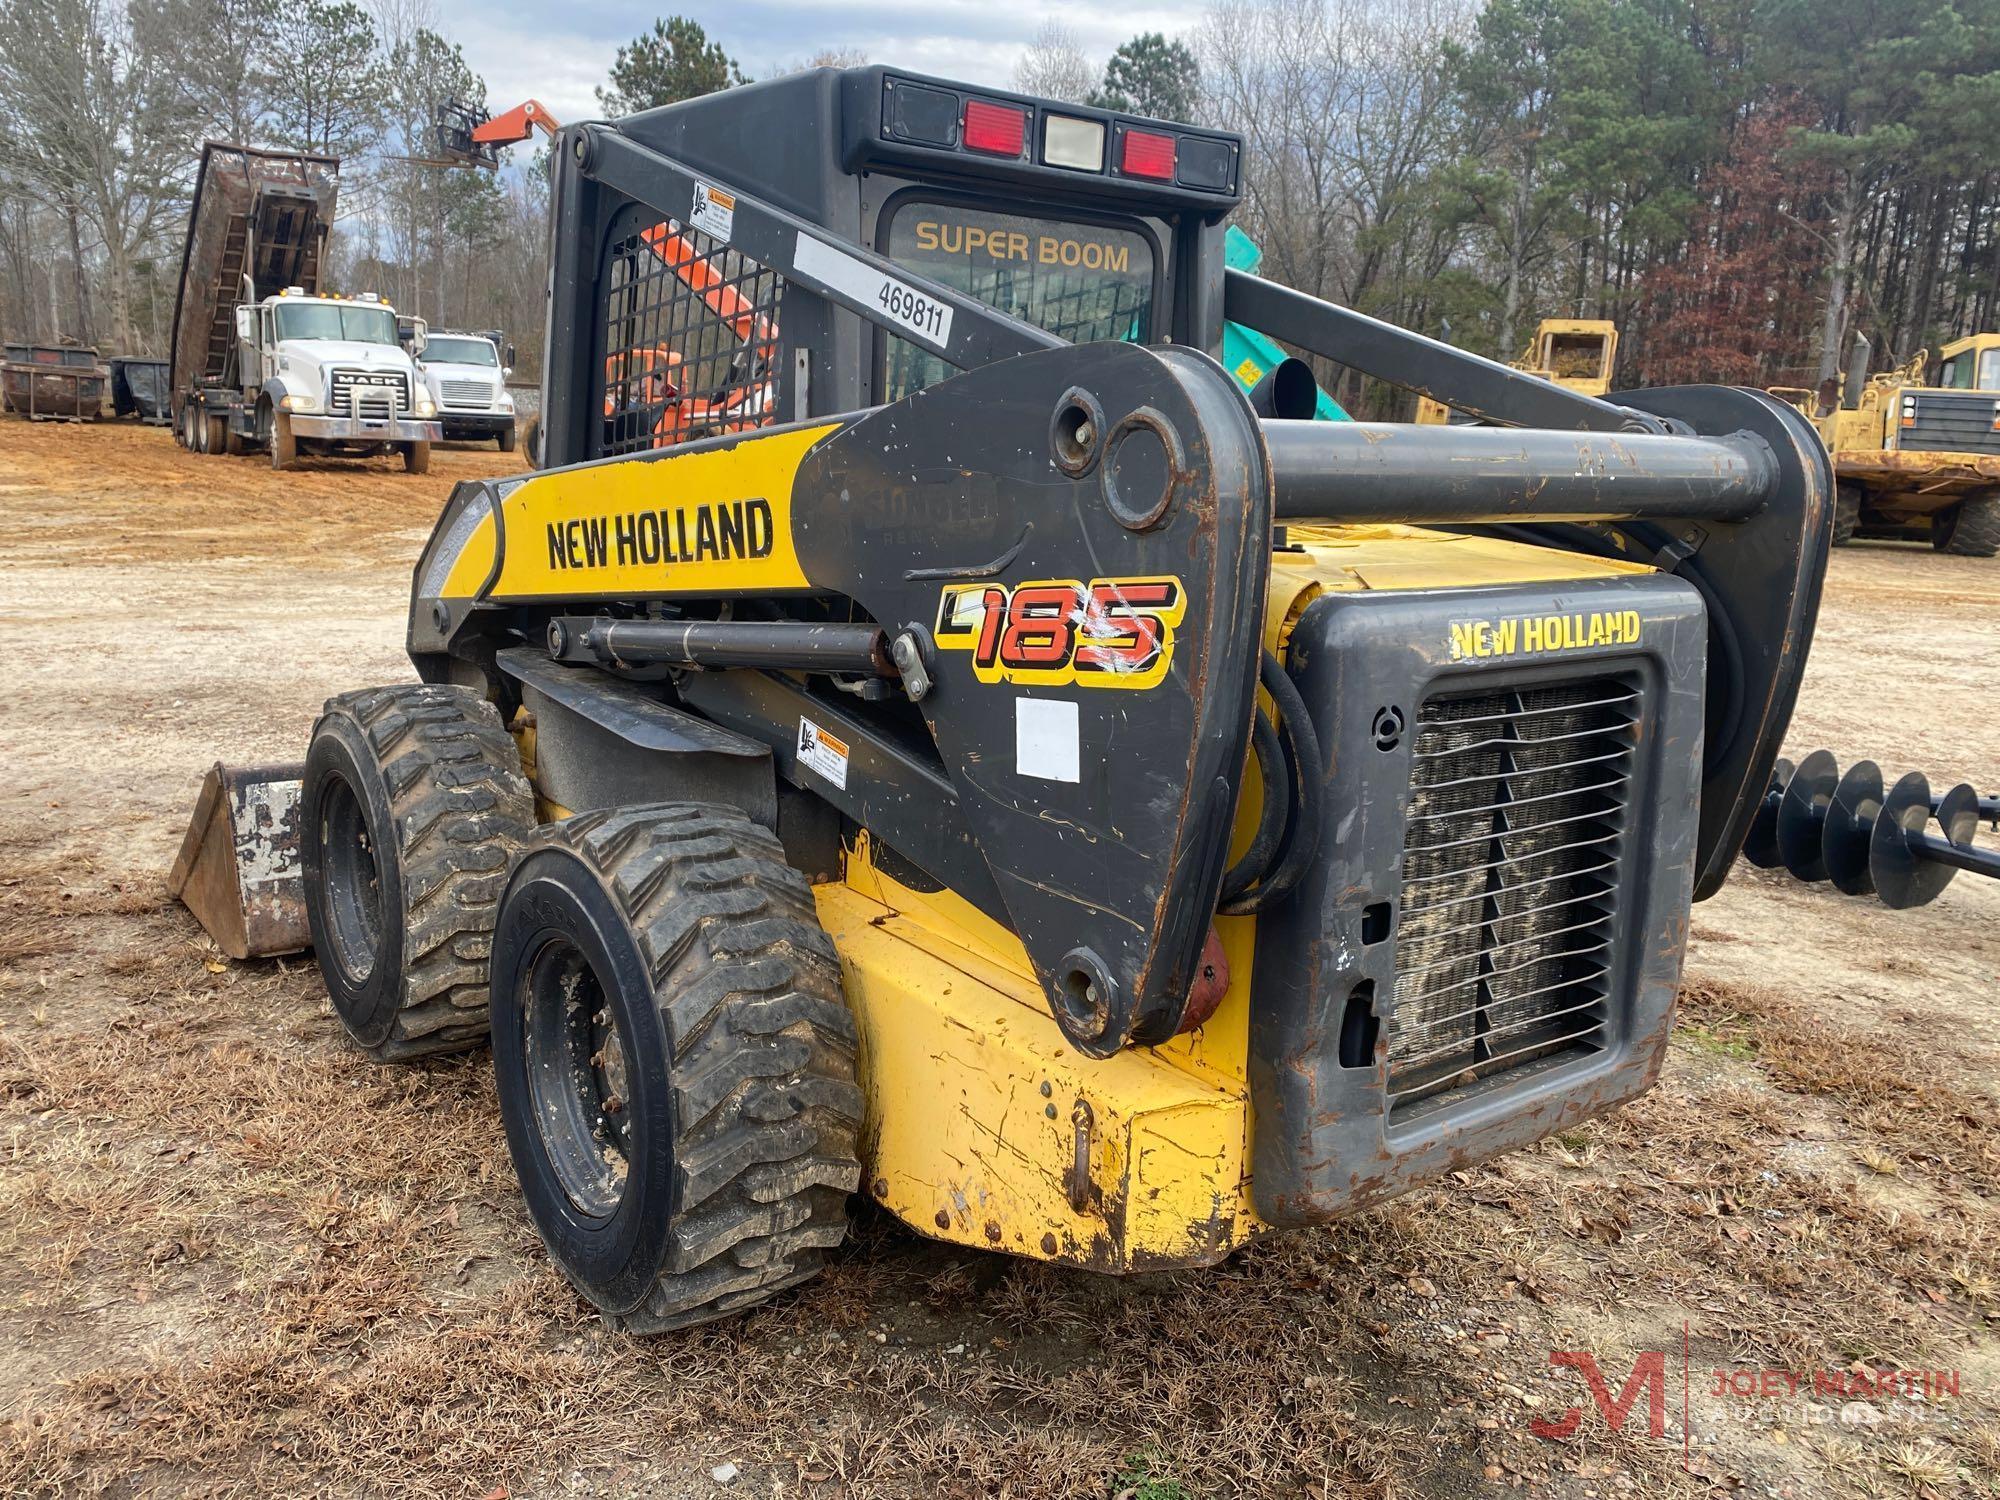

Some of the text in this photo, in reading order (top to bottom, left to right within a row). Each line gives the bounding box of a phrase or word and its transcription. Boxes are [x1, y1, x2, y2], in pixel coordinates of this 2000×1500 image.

[916, 221, 1128, 272] SUPER BOOM
[878, 281, 944, 337] 469811
[338, 375, 400, 385] MACK
[546, 497, 774, 570] NEW HOLLAND
[1450, 610, 1641, 660] NEW HOLLAND
